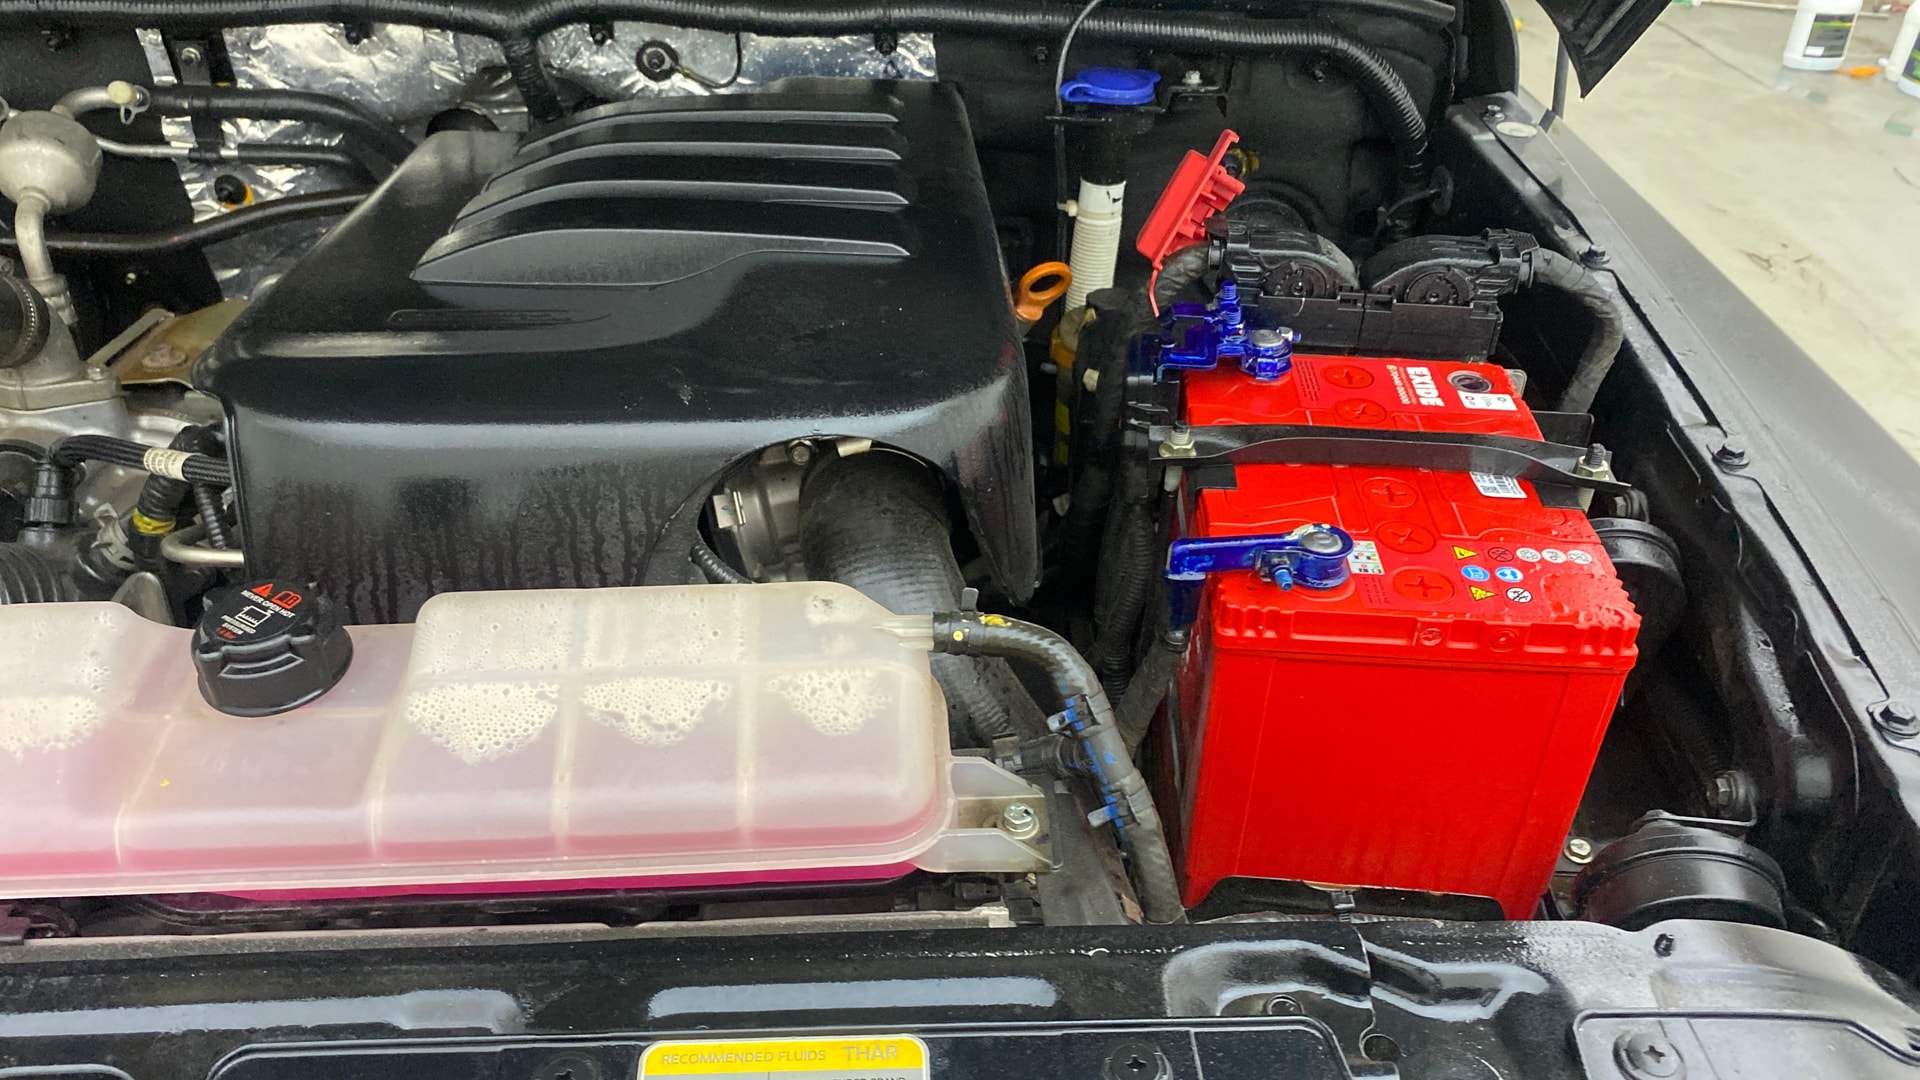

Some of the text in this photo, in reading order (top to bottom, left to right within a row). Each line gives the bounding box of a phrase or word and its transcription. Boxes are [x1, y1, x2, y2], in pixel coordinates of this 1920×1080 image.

[1406, 366, 1445, 407] EXIDE
[240, 589, 296, 619] NEVER OPEN HOT
[661, 1045, 899, 1065] RECOMMENDED FLUIDS THAR
